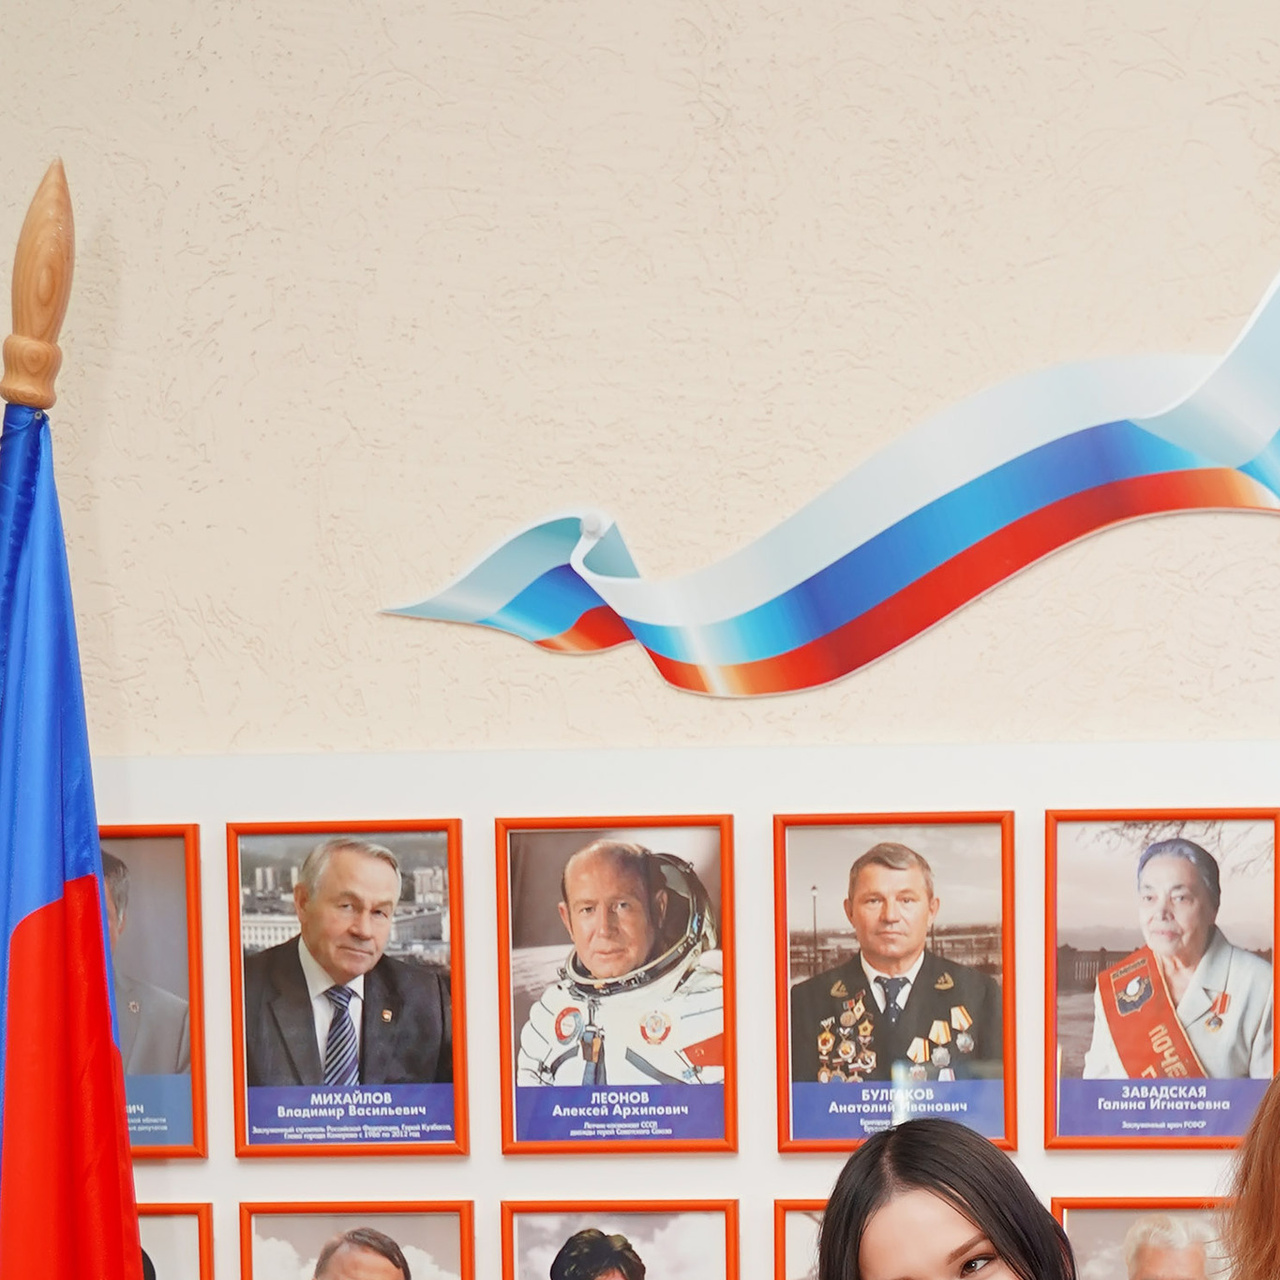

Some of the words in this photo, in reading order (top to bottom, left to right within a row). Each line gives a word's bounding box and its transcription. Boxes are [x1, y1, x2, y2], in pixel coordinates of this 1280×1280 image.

[310, 1090, 392, 1105] МИХАЙЛОВ
[591, 1091, 649, 1105] ЛЕОНОВ
[1121, 1086, 1207, 1100] ЗАВАДСКАЯ
[828, 1101, 895, 1114] Анатолий
[902, 1102, 967, 1112] Иванович
[1097, 1098, 1146, 1110] Галина
[1149, 1098, 1231, 1110] Игнатьевна
[277, 1105, 345, 1120] Владимир
[348, 1104, 427, 1117] Васильевич
[552, 1104, 609, 1117] Алексей
[612, 1104, 688, 1119] Архипович
